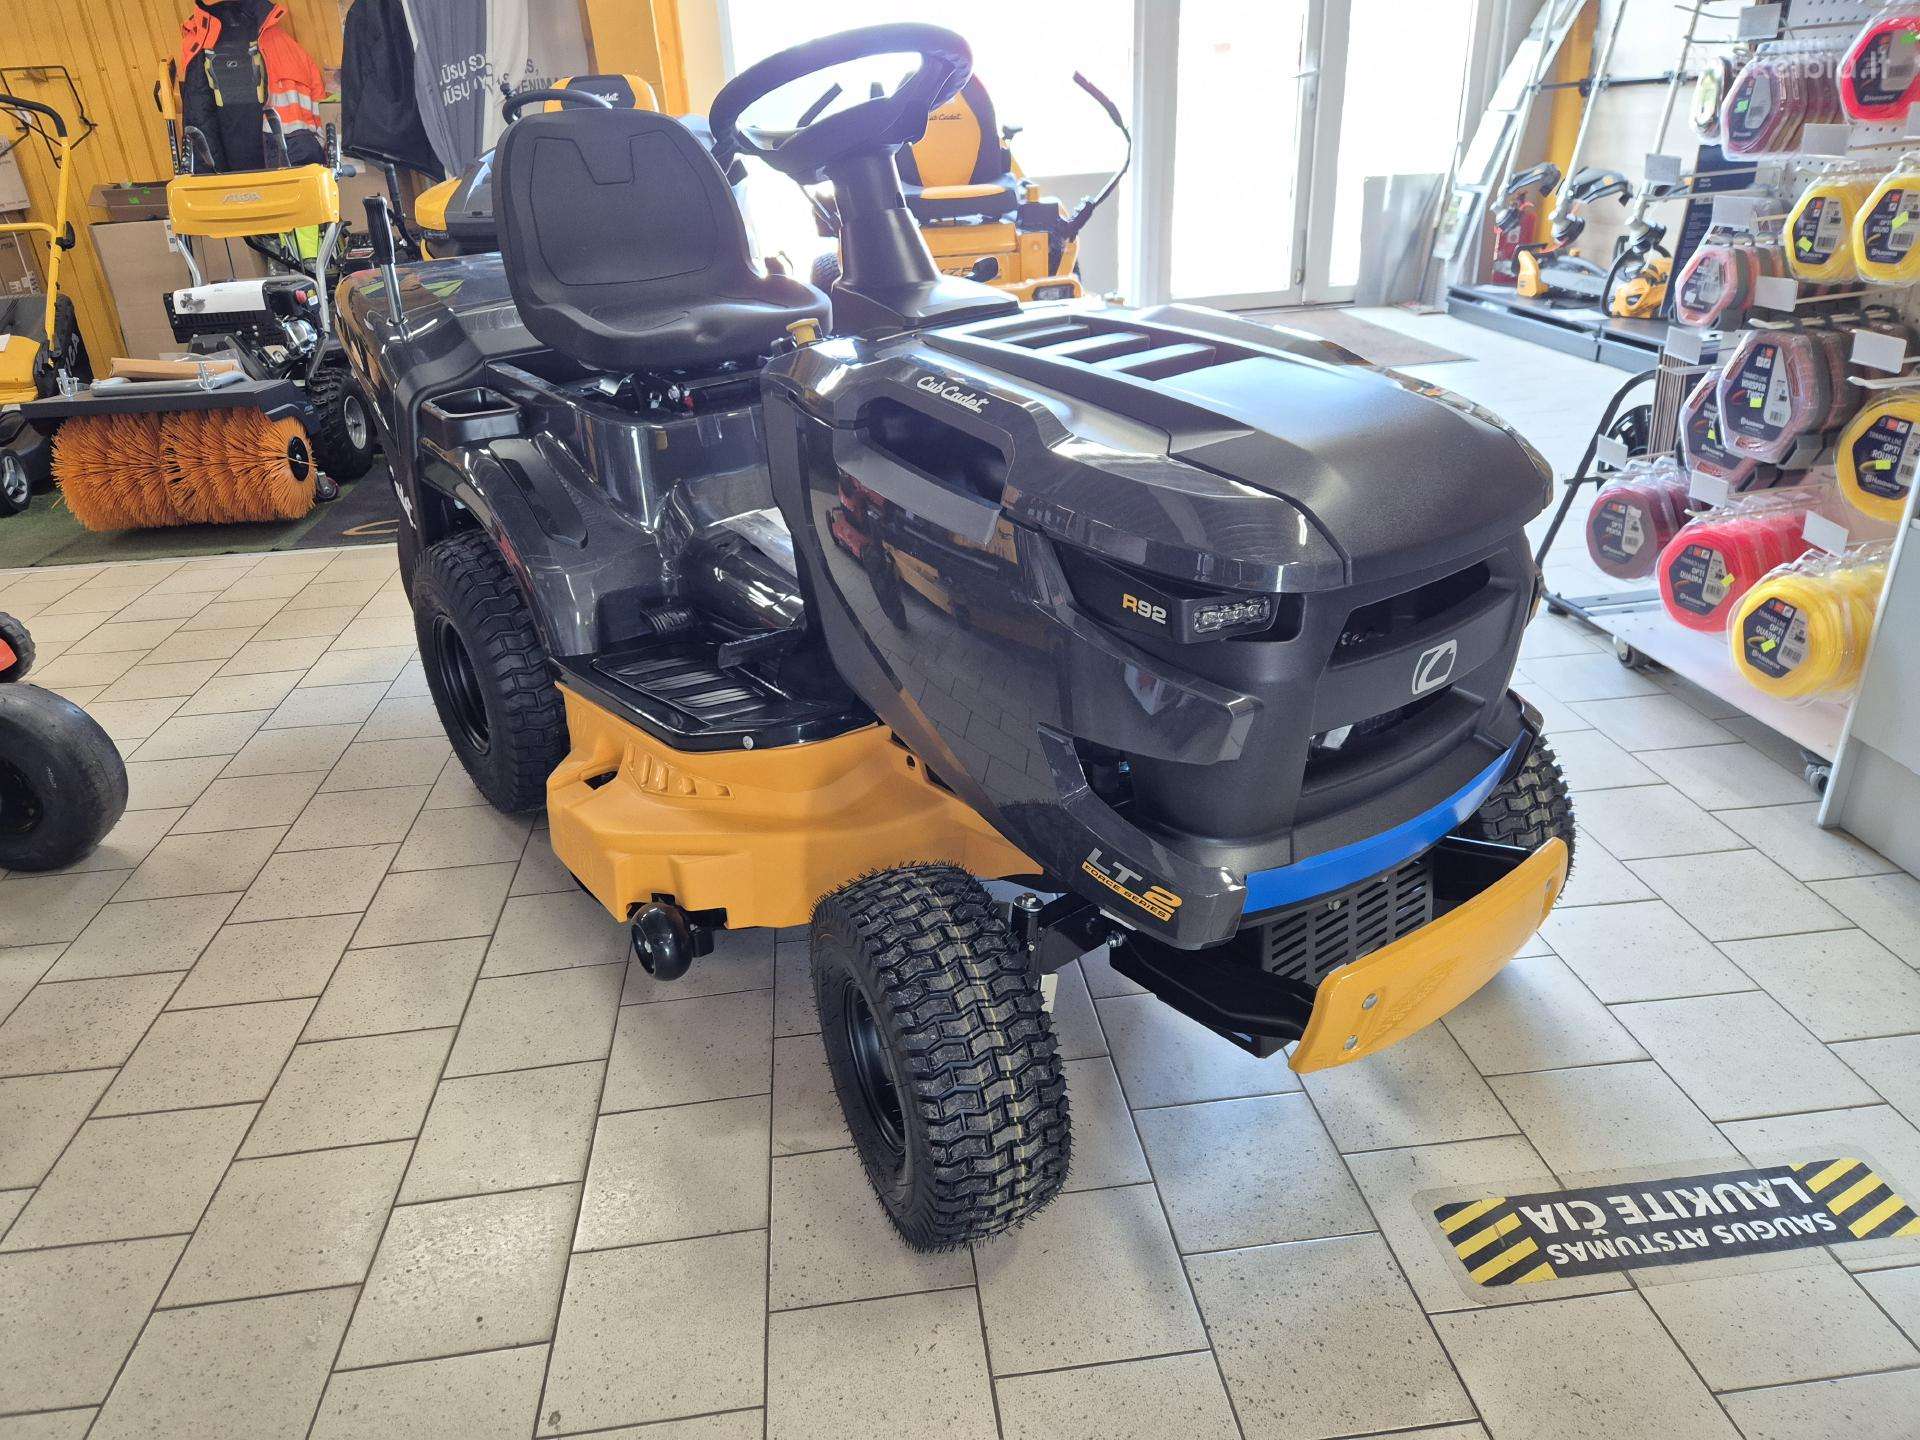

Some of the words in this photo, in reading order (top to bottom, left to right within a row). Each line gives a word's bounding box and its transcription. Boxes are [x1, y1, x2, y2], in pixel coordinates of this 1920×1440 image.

[916, 376, 947, 394] Cub
[940, 386, 990, 413] Cadet
[1883, 443, 1901, 456] OPTI
[1122, 593, 1167, 625] R92
[1084, 863, 1121, 893] FORCE
[1123, 889, 1167, 918] SERIES
[1518, 1200, 1607, 1236] ČIA
[1607, 1176, 1813, 1225] LAUKITE
[1546, 1227, 1709, 1265] ATSTUMAS
[1711, 1212, 1837, 1244] SAUGUS
